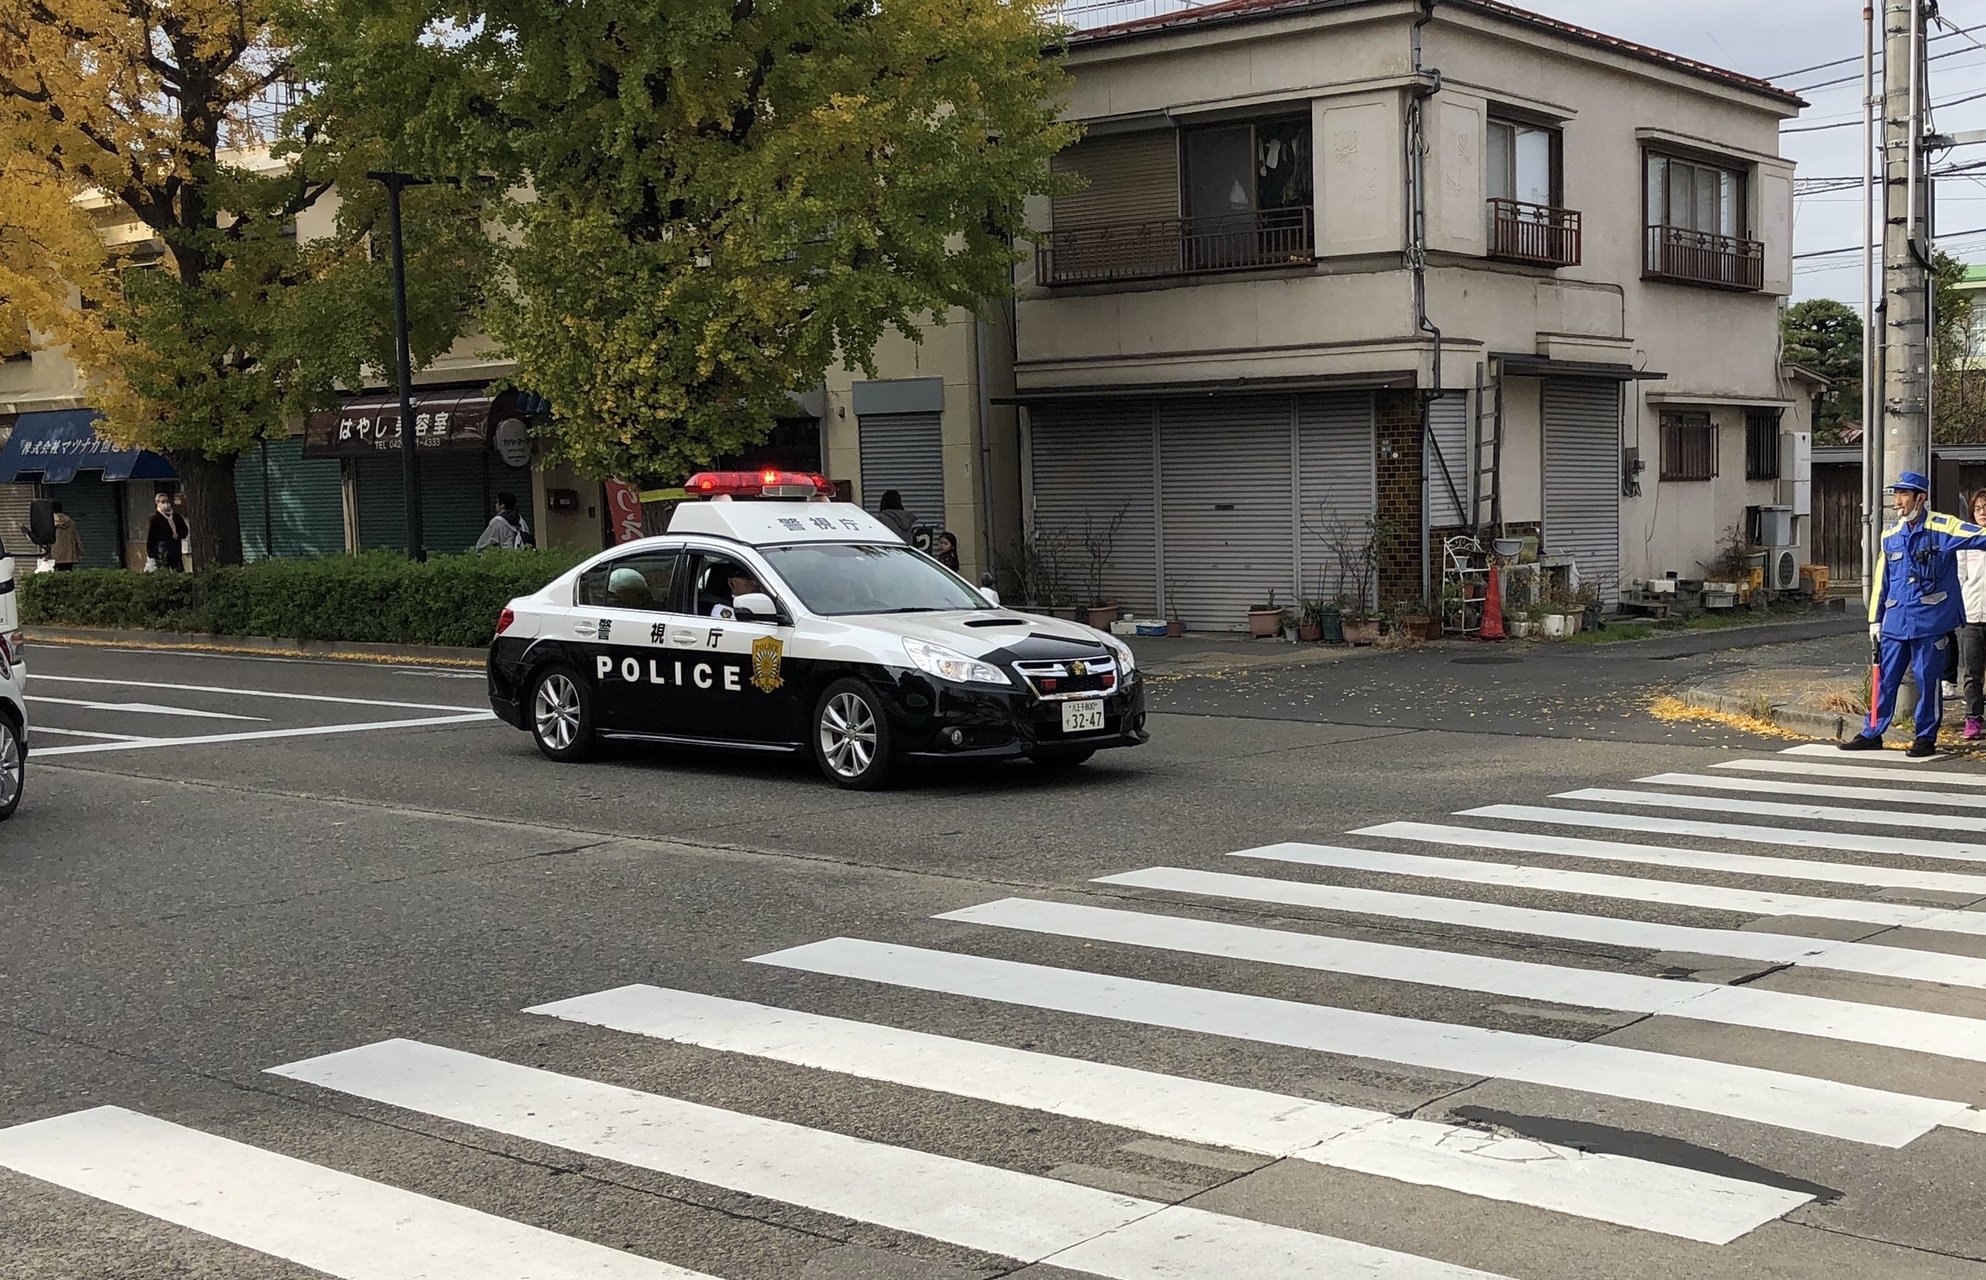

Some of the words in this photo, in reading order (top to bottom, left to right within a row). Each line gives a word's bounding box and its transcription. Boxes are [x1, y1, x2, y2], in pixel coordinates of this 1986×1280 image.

[375, 441, 387, 450] TEL
[597, 618, 724, 648] 警視庁
[596, 655, 742, 692] POLICE
